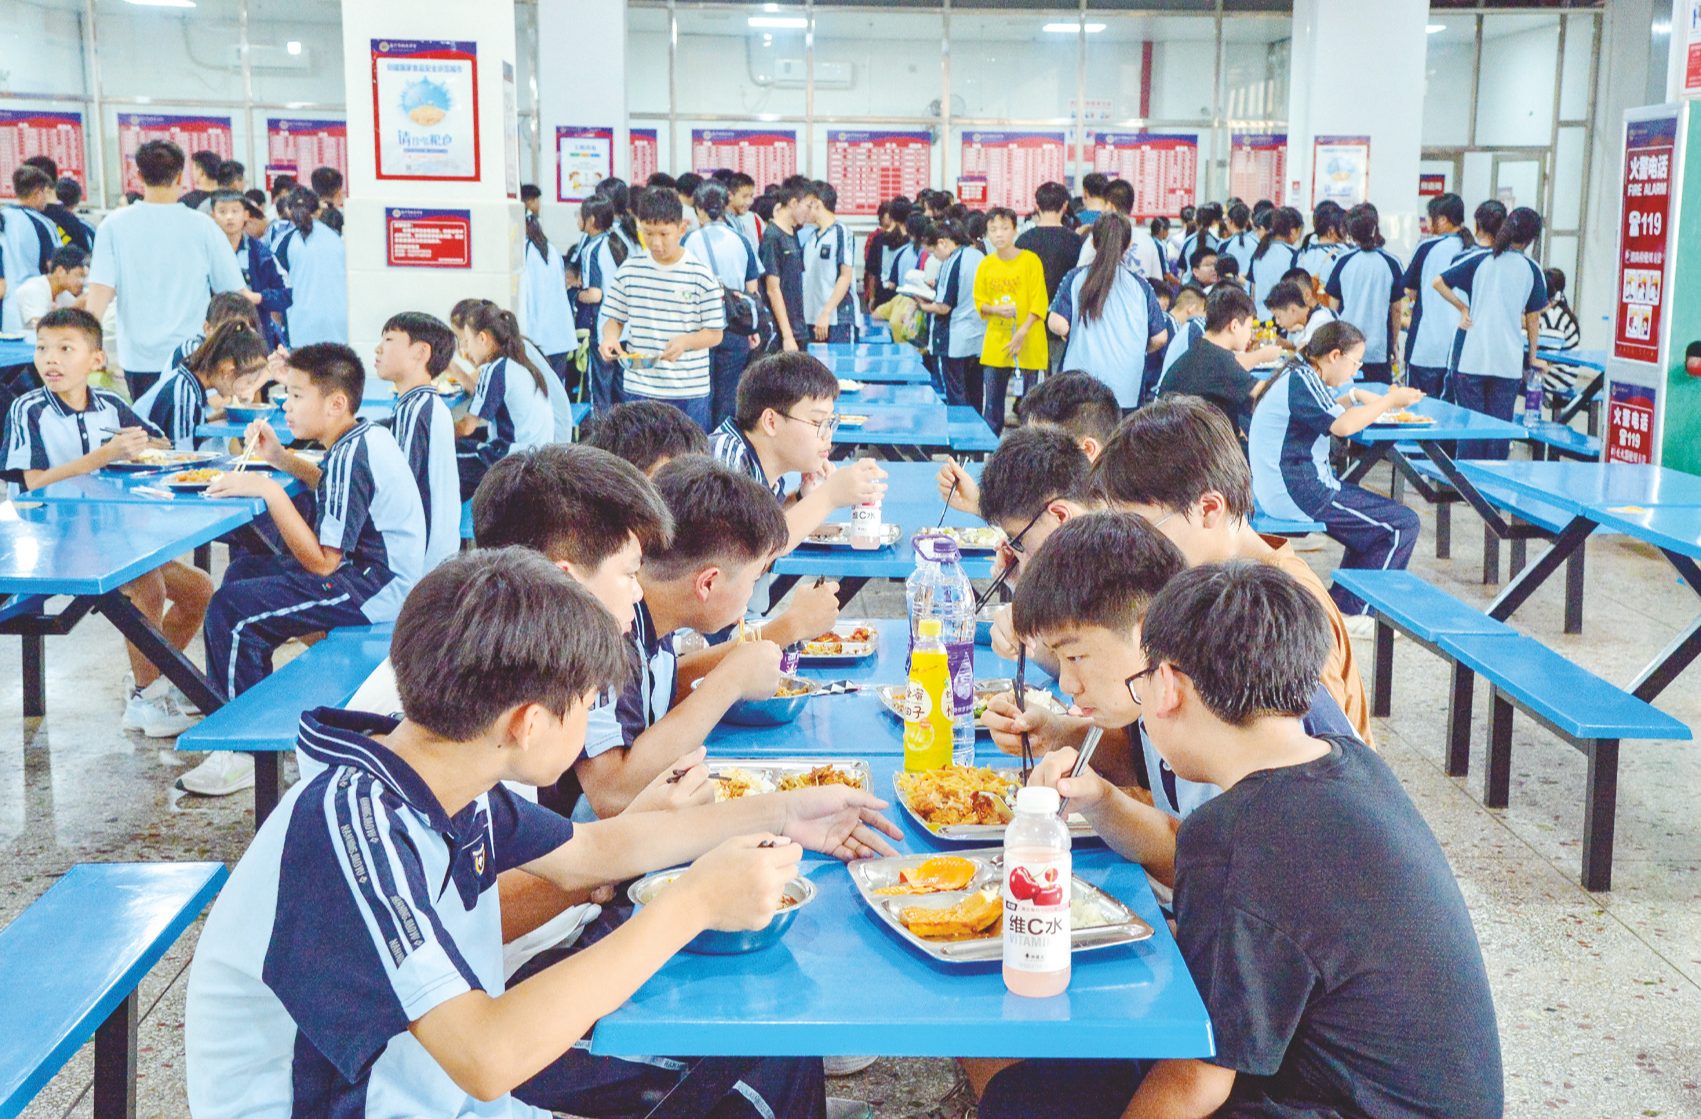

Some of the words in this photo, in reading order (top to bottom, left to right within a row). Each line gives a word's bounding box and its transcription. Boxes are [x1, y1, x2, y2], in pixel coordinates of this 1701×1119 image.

[1629, 154, 1669, 181] 火警电话
[1627, 183, 1642, 197] FIRE
[1643, 182, 1667, 196] ALARM
[1641, 212, 1662, 236] 119
[1613, 406, 1649, 433] 火警电话
[1627, 432, 1641, 449] 119
[1009, 914, 1062, 935] 维C水
